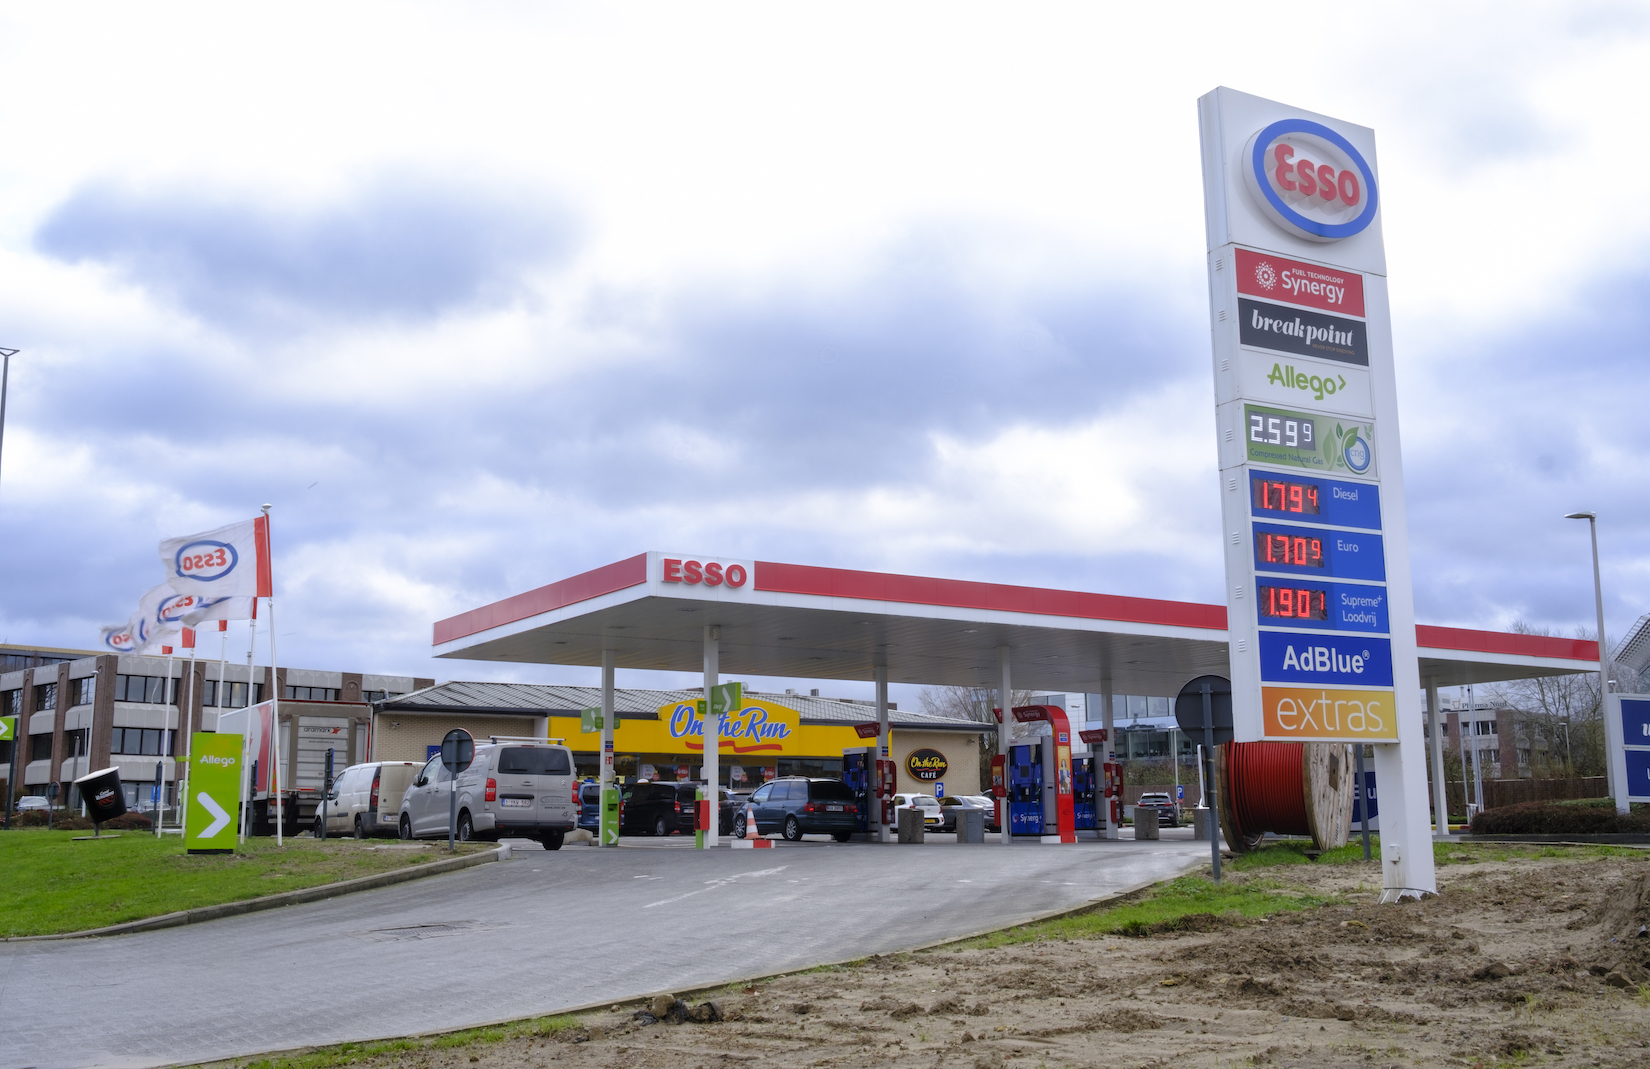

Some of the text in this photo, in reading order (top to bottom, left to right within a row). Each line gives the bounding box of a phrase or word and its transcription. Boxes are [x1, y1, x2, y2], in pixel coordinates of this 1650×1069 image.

[1274, 144, 1360, 206] ESSO
[1292, 268, 1344, 284] FUEL TECHNOLOGY
[1282, 270, 1344, 304] Synergy
[1266, 363, 1336, 400] Allego
[1250, 448, 1324, 465] Compressed Natural Gas
[1350, 448, 1365, 460] cng
[1333, 487, 1358, 501] Diesel
[1337, 540, 1359, 552] Euro
[664, 558, 747, 588] ESSO
[1342, 610, 1377, 627] Loodvrij
[1277, 691, 1383, 732] extras
[670, 704, 792, 743] On the Run
[200, 755, 235, 767] Allego
[931, 757, 947, 769] Run
[936, 784, 943, 795] P
[1178, 787, 1182, 796] P
